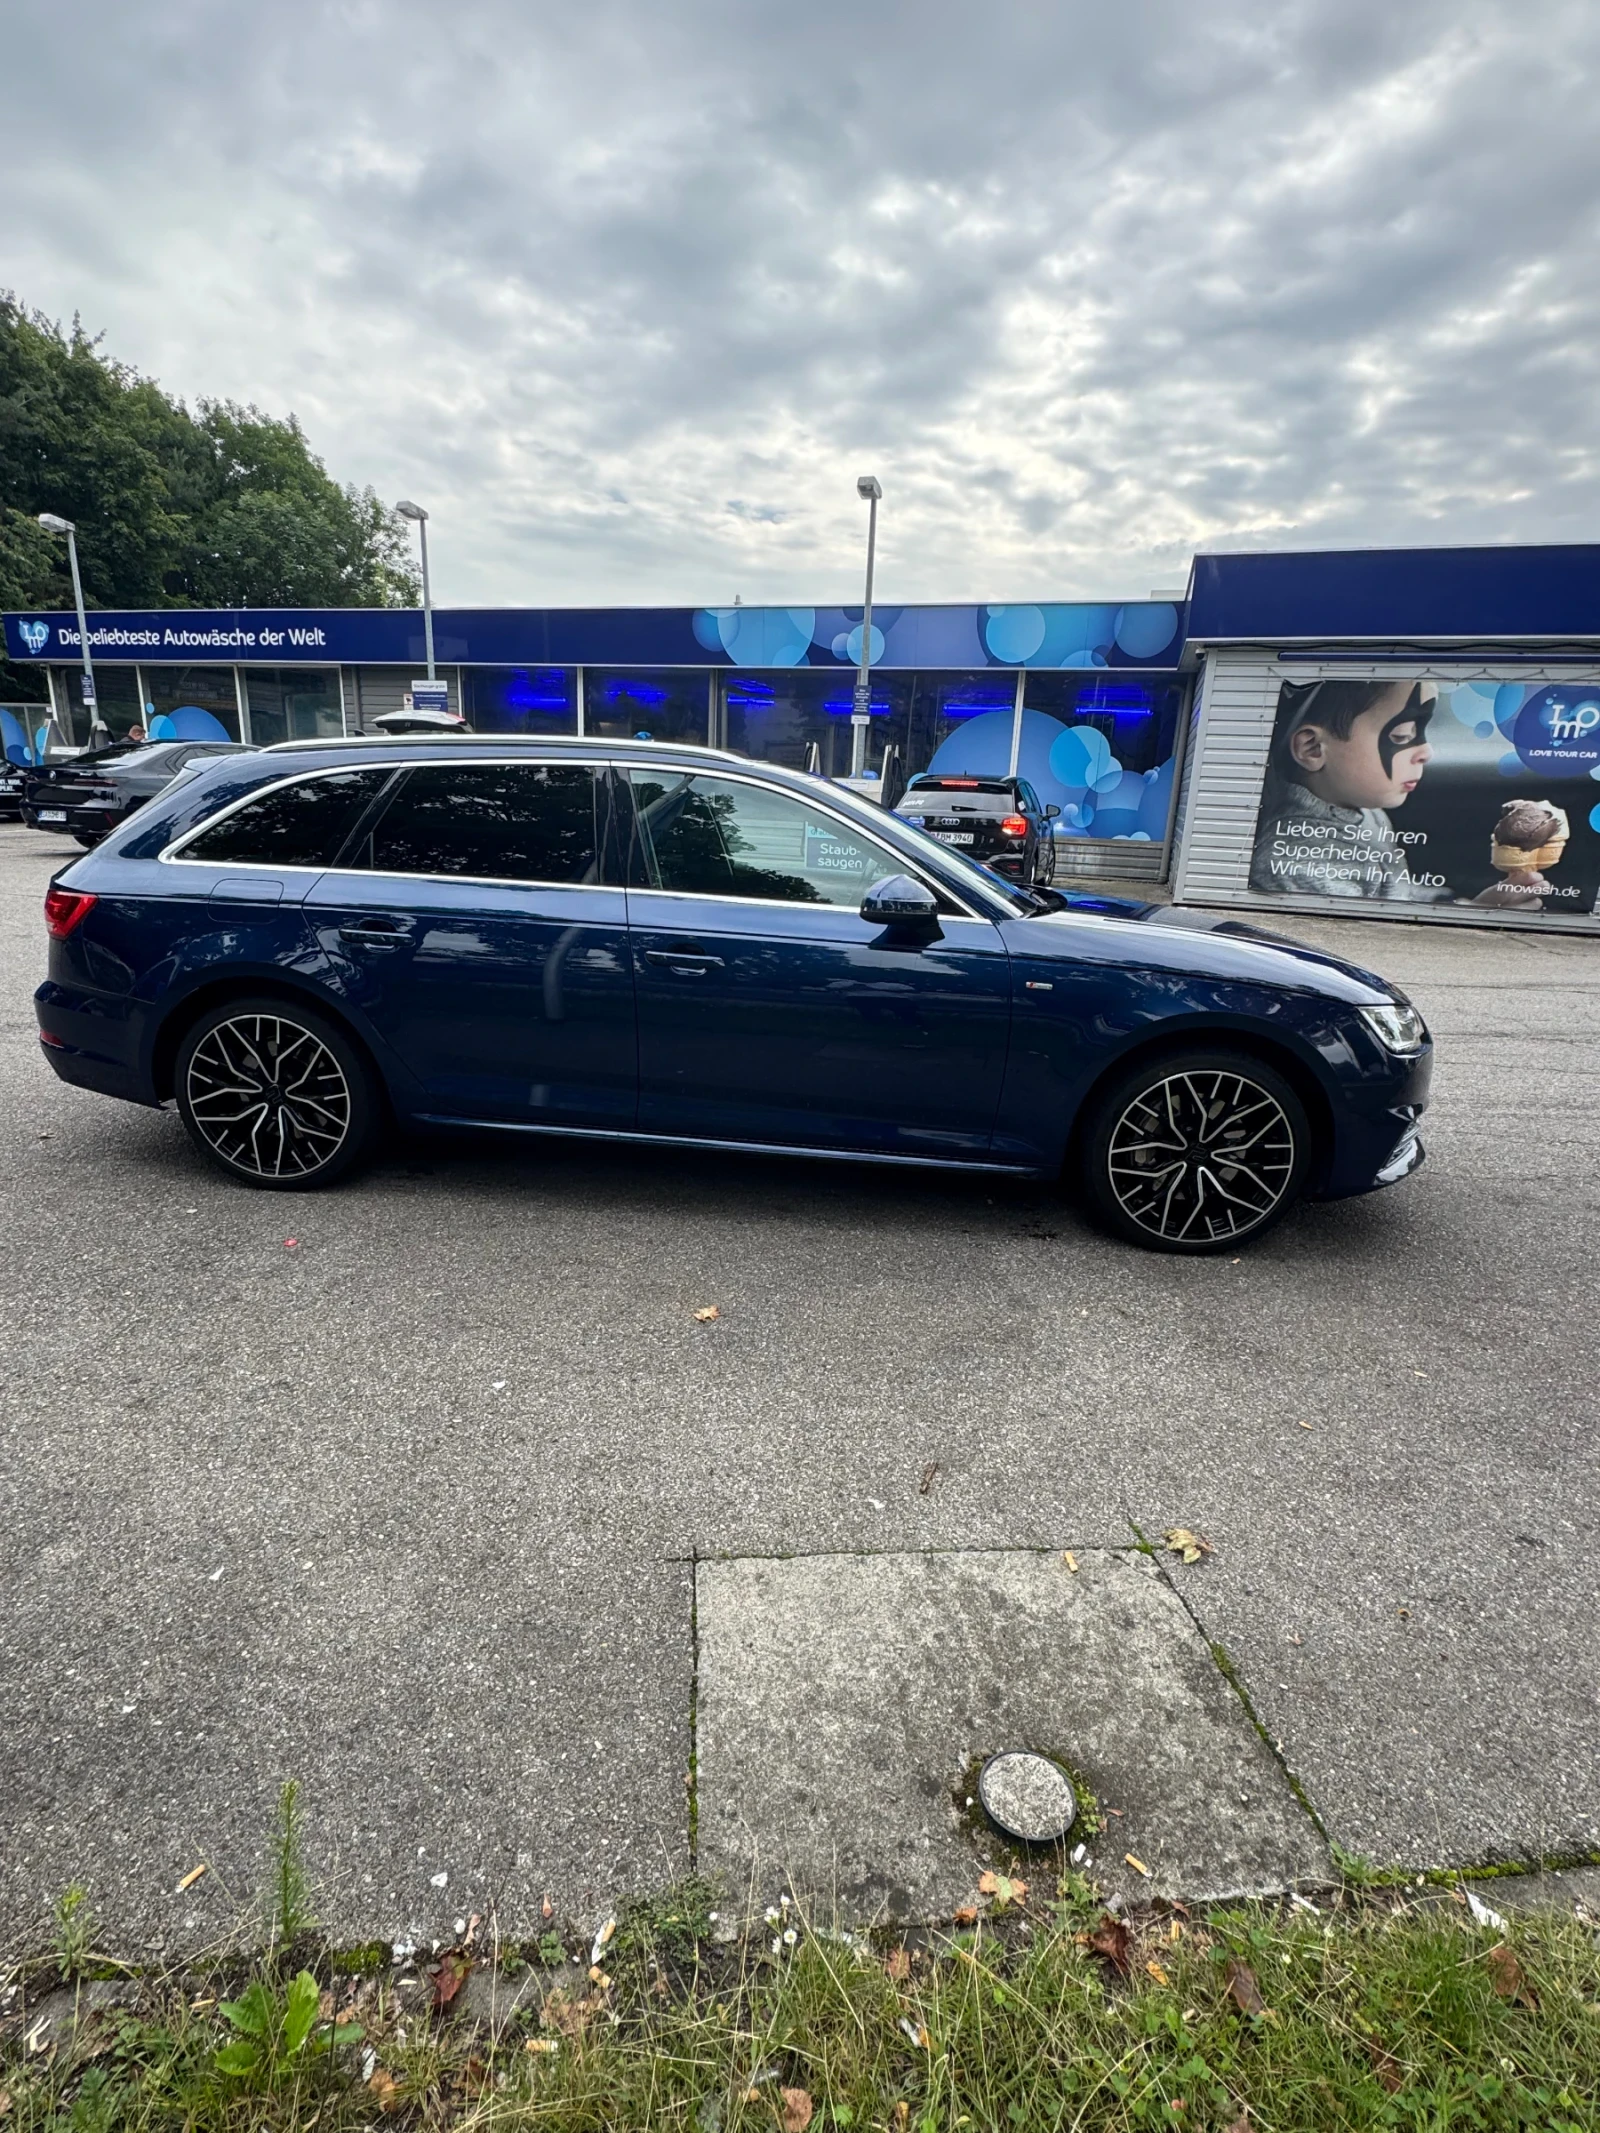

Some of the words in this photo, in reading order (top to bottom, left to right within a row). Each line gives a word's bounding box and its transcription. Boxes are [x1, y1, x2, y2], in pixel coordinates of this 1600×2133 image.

[58, 628, 81, 645] Die
[163, 628, 256, 646] Autowäsche
[259, 627, 286, 646] der
[288, 627, 326, 646] Welt
[1529, 749, 1553, 757] LOVE
[1553, 750, 1578, 758] YOUR
[1579, 751, 1598, 759] CAR
[1275, 820, 1337, 839] Lieben
[1342, 824, 1373, 841] Sie
[1377, 825, 1428, 845] Ihren
[820, 843, 861, 856] Staub-
[1271, 840, 1406, 864] Superhelden?
[817, 857, 863, 870] saugen
[1269, 859, 1303, 876] Wir
[1306, 862, 1361, 881] lieben
[1366, 866, 1394, 883] Ihr
[1395, 868, 1446, 887] Auto
[1496, 880, 1581, 898] imowash.de
